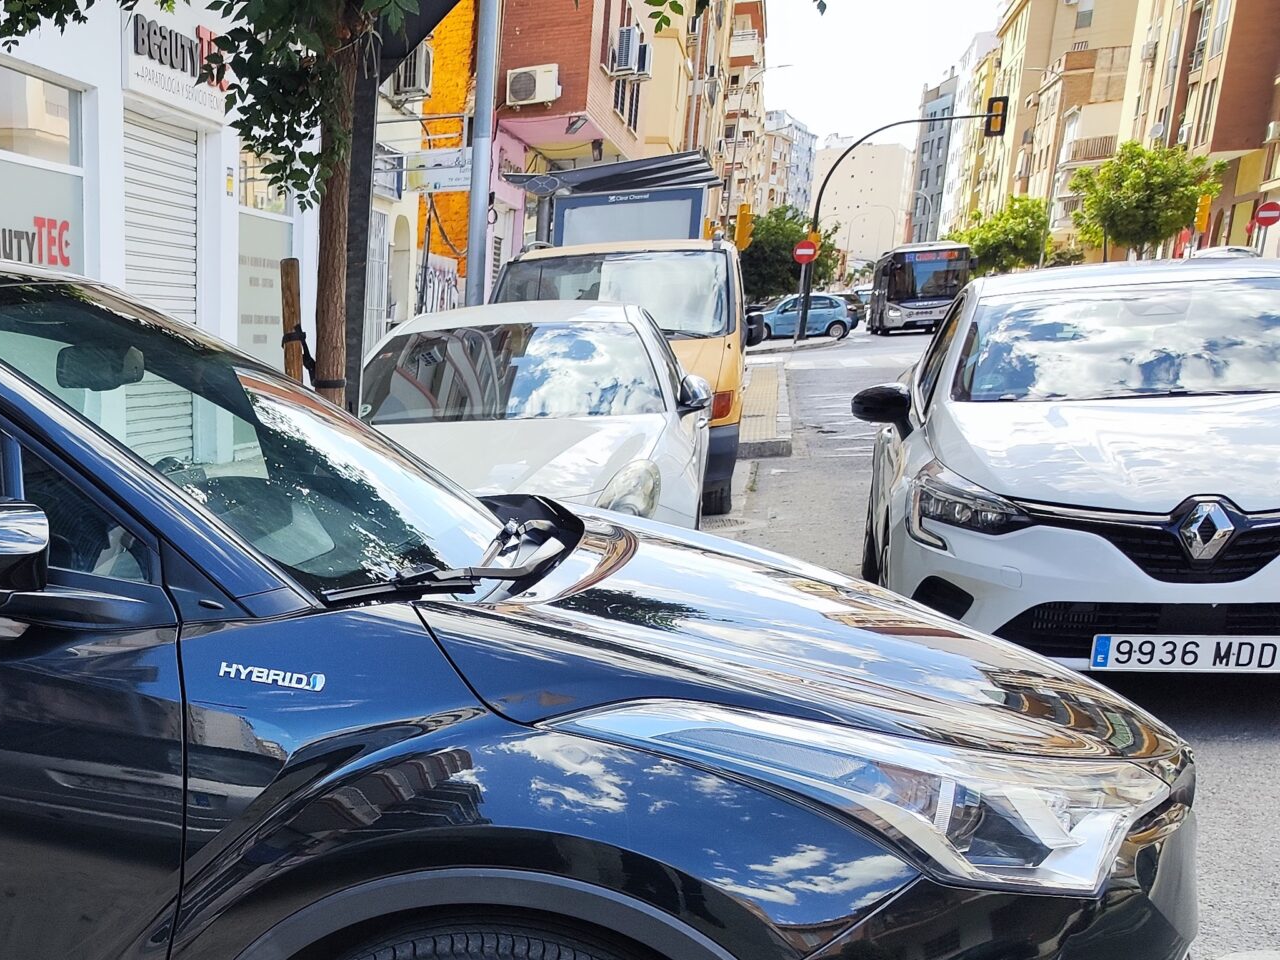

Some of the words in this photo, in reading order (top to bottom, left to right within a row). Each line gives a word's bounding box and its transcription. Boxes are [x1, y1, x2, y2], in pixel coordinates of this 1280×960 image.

[1096, 654, 1105, 663] E
[1114, 640, 1200, 666] 9936
[1212, 641, 1278, 668] MDD
[219, 661, 308, 689] HYBRID
